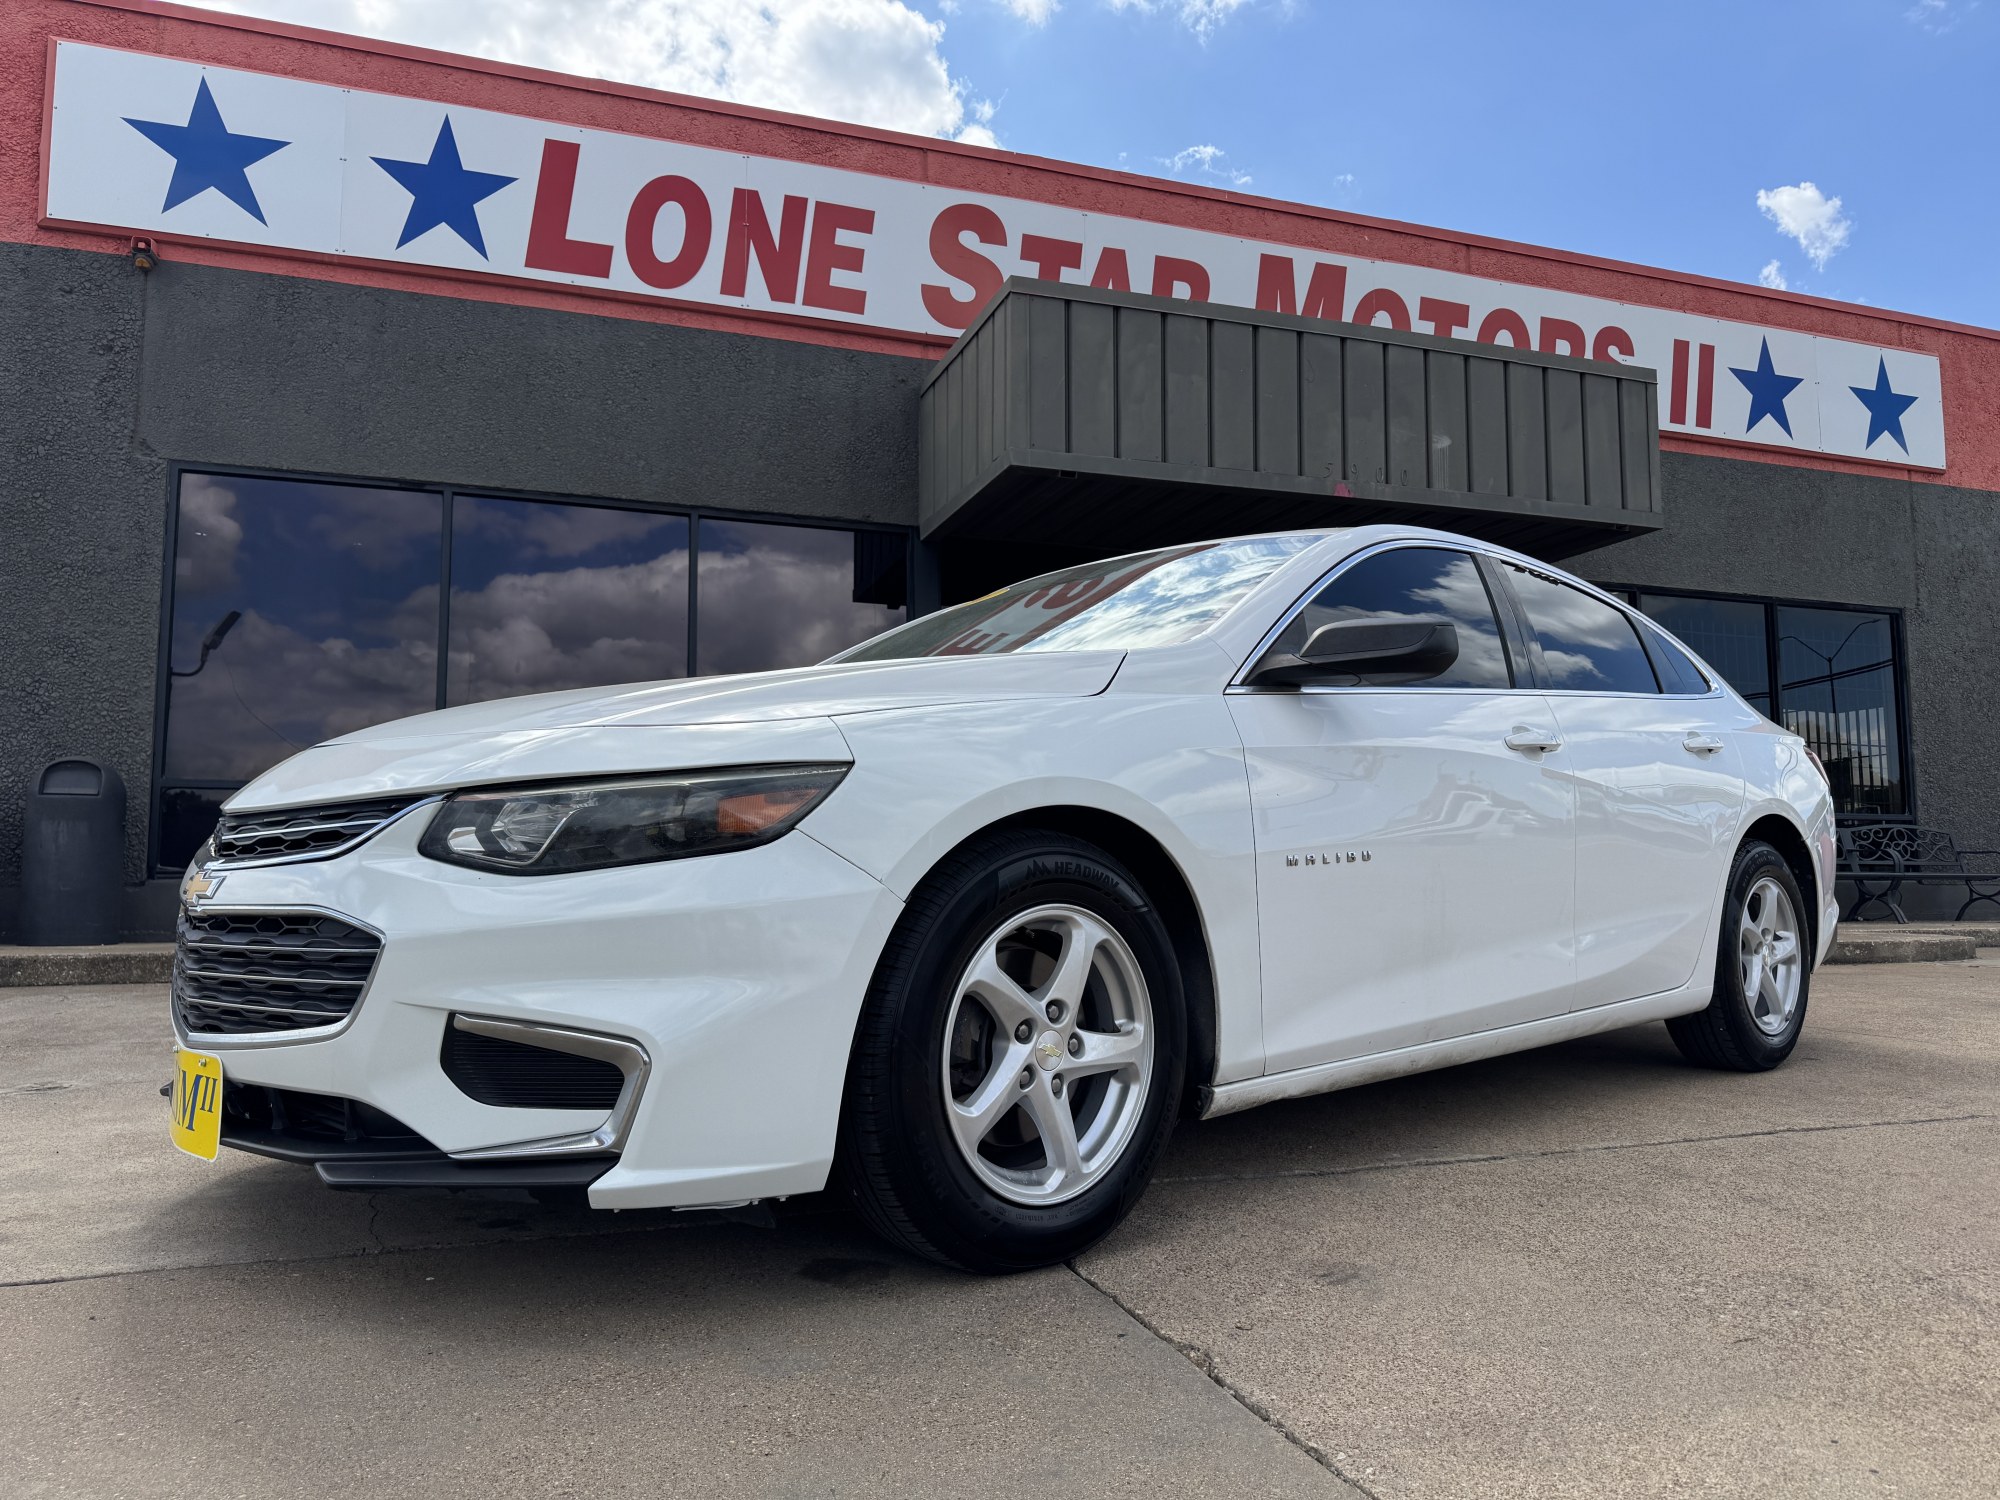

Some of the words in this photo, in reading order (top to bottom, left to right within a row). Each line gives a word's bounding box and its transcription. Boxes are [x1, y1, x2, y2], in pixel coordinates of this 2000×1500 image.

[525, 138, 876, 315] LONE
[1670, 338, 1715, 429] II
[1286, 850, 1371, 867] MALIBU
[1055, 861, 1120, 889] HEADWAY
